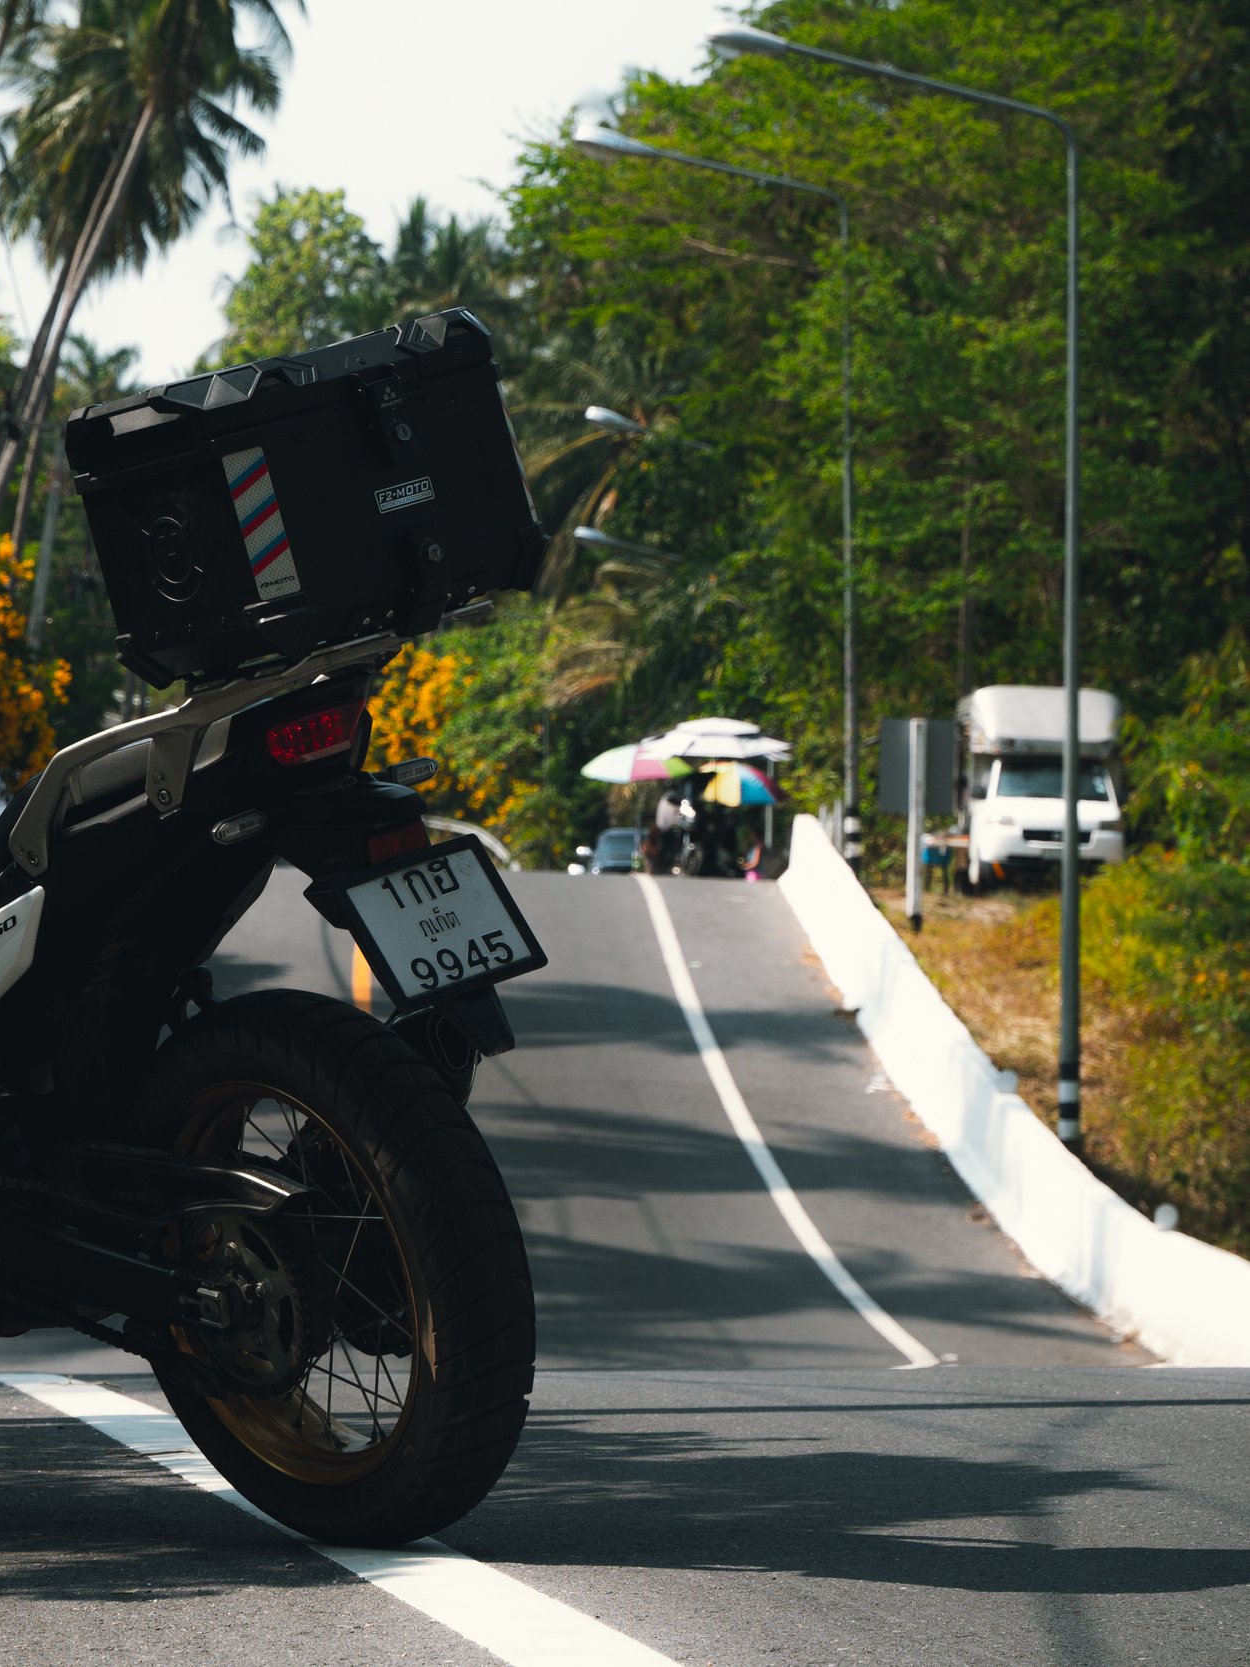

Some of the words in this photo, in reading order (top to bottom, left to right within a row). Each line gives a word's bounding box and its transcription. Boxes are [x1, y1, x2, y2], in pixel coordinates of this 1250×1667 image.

[378, 480, 429, 503] F2-MOTO
[418, 906, 463, 944] ภูเก็ต
[409, 929, 515, 990] 9945
